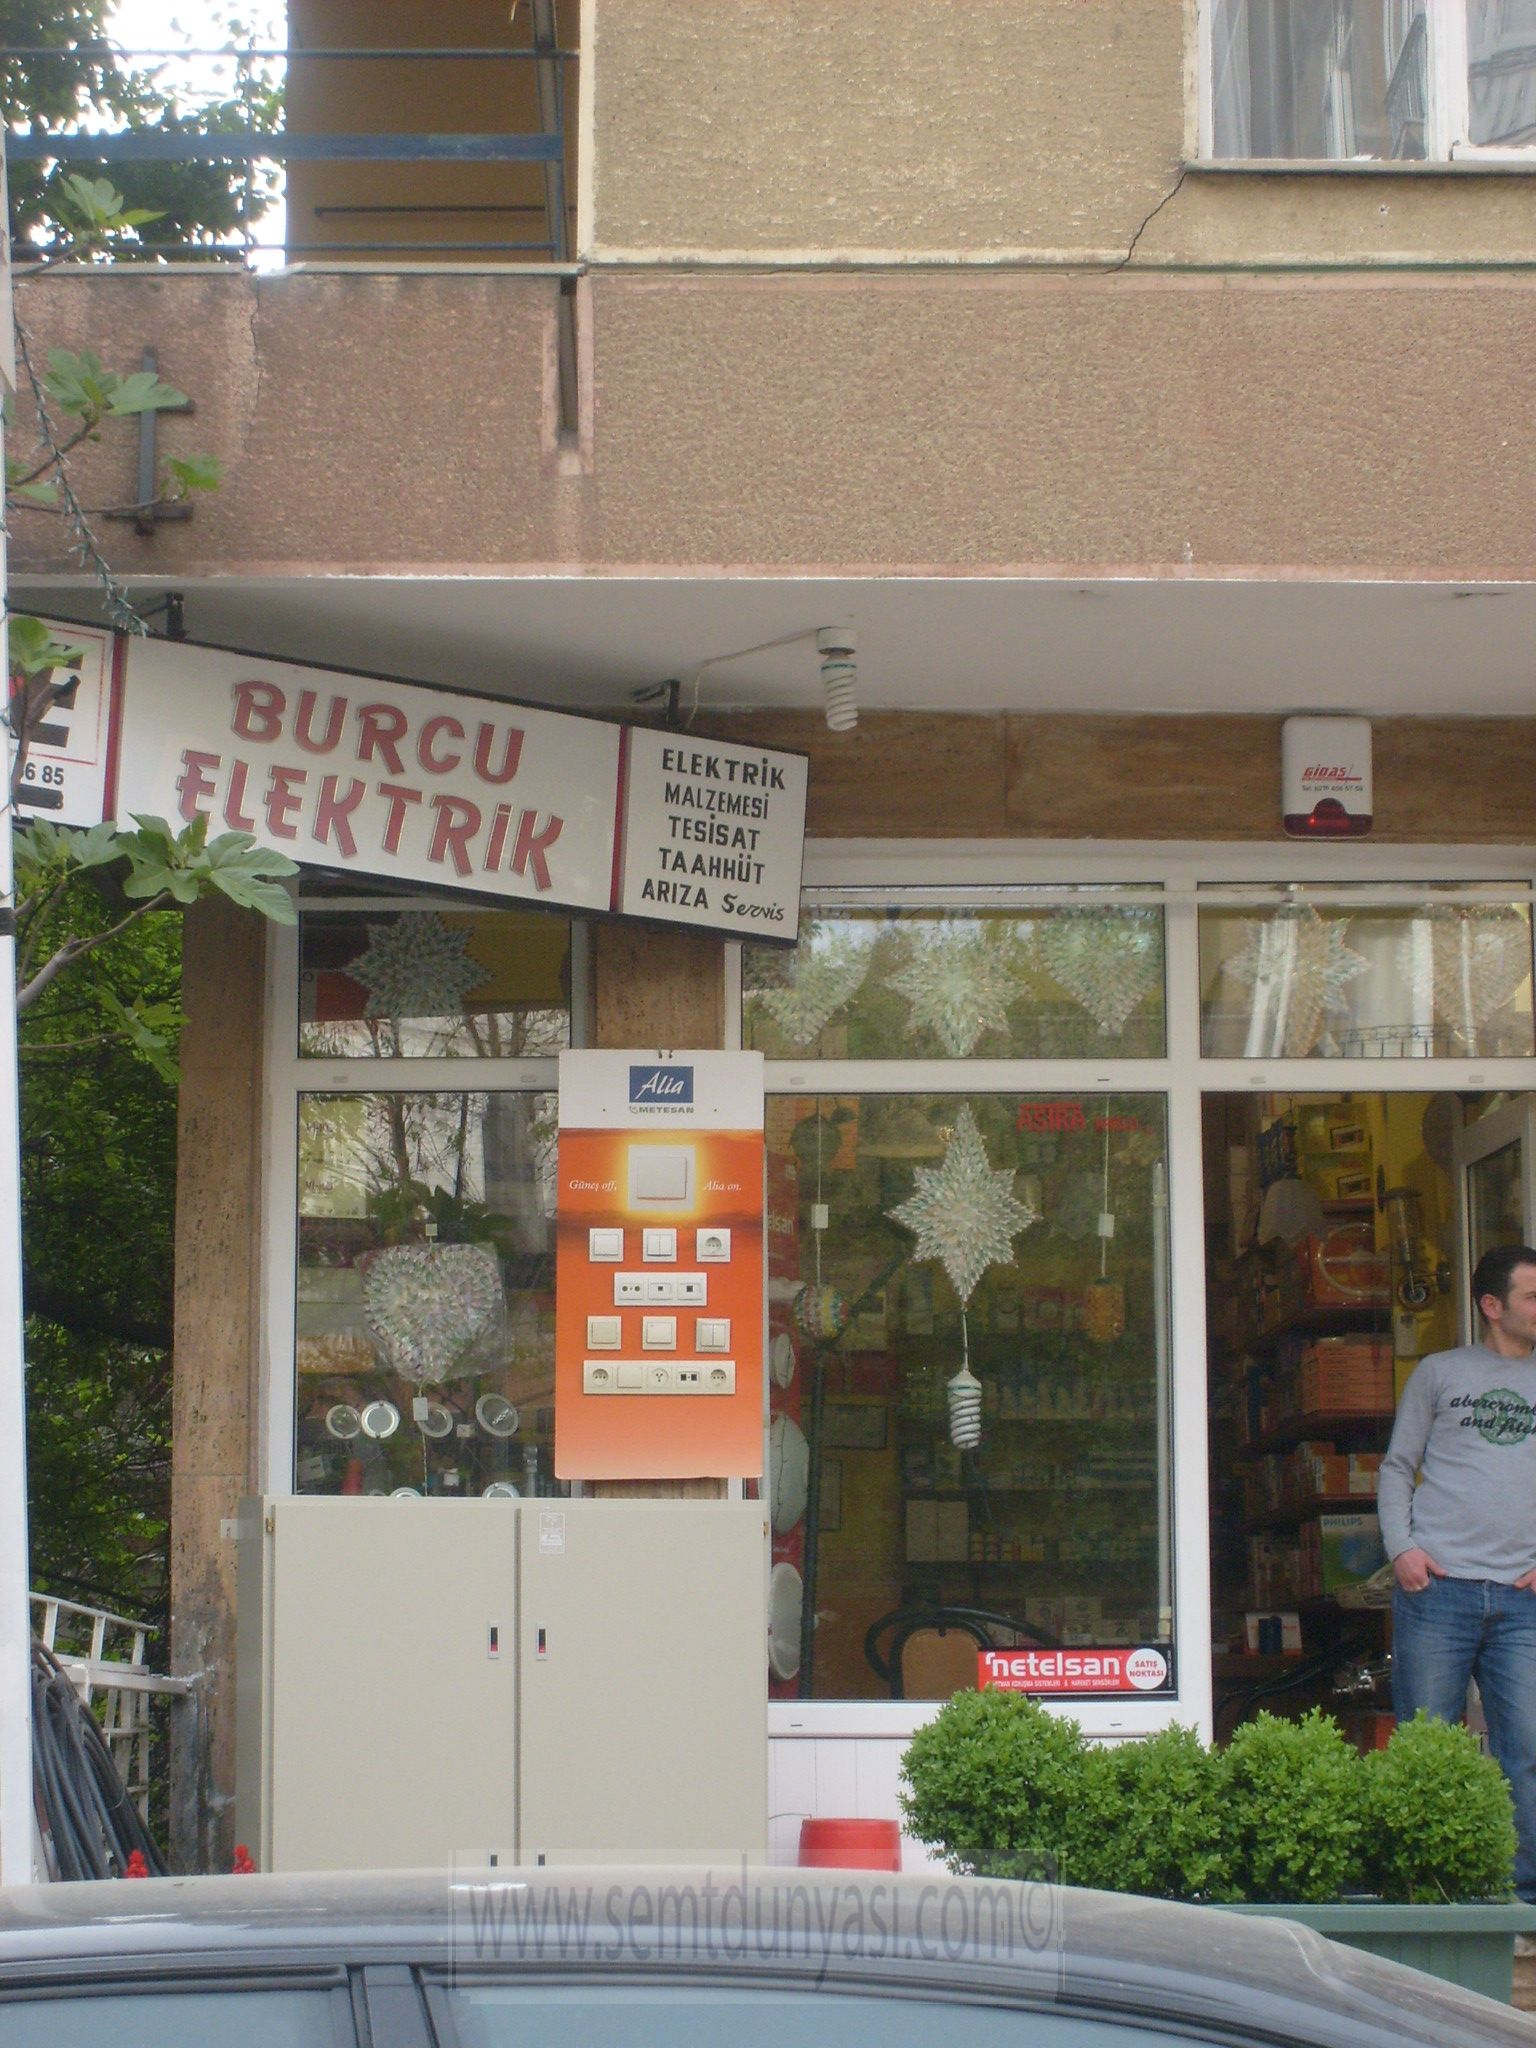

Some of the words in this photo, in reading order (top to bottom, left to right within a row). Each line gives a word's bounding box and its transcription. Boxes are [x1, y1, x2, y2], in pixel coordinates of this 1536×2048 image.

[231, 680, 525, 784] BURCU
[42, 765, 64, 785] 85
[662, 748, 786, 790] ELEKTRİK
[664, 781, 770, 820] MALZEMESİ
[668, 812, 761, 851] TESİSAT
[658, 847, 766, 885] TAAHHÜT
[641, 878, 709, 909] ARIZA
[721, 893, 785, 922] Servis
[635, 1071, 685, 1100] Alia
[638, 1106, 695, 1114] METESAN
[1460, 1415, 1497, 1429] and
[987, 1652, 1120, 1677] netelsan
